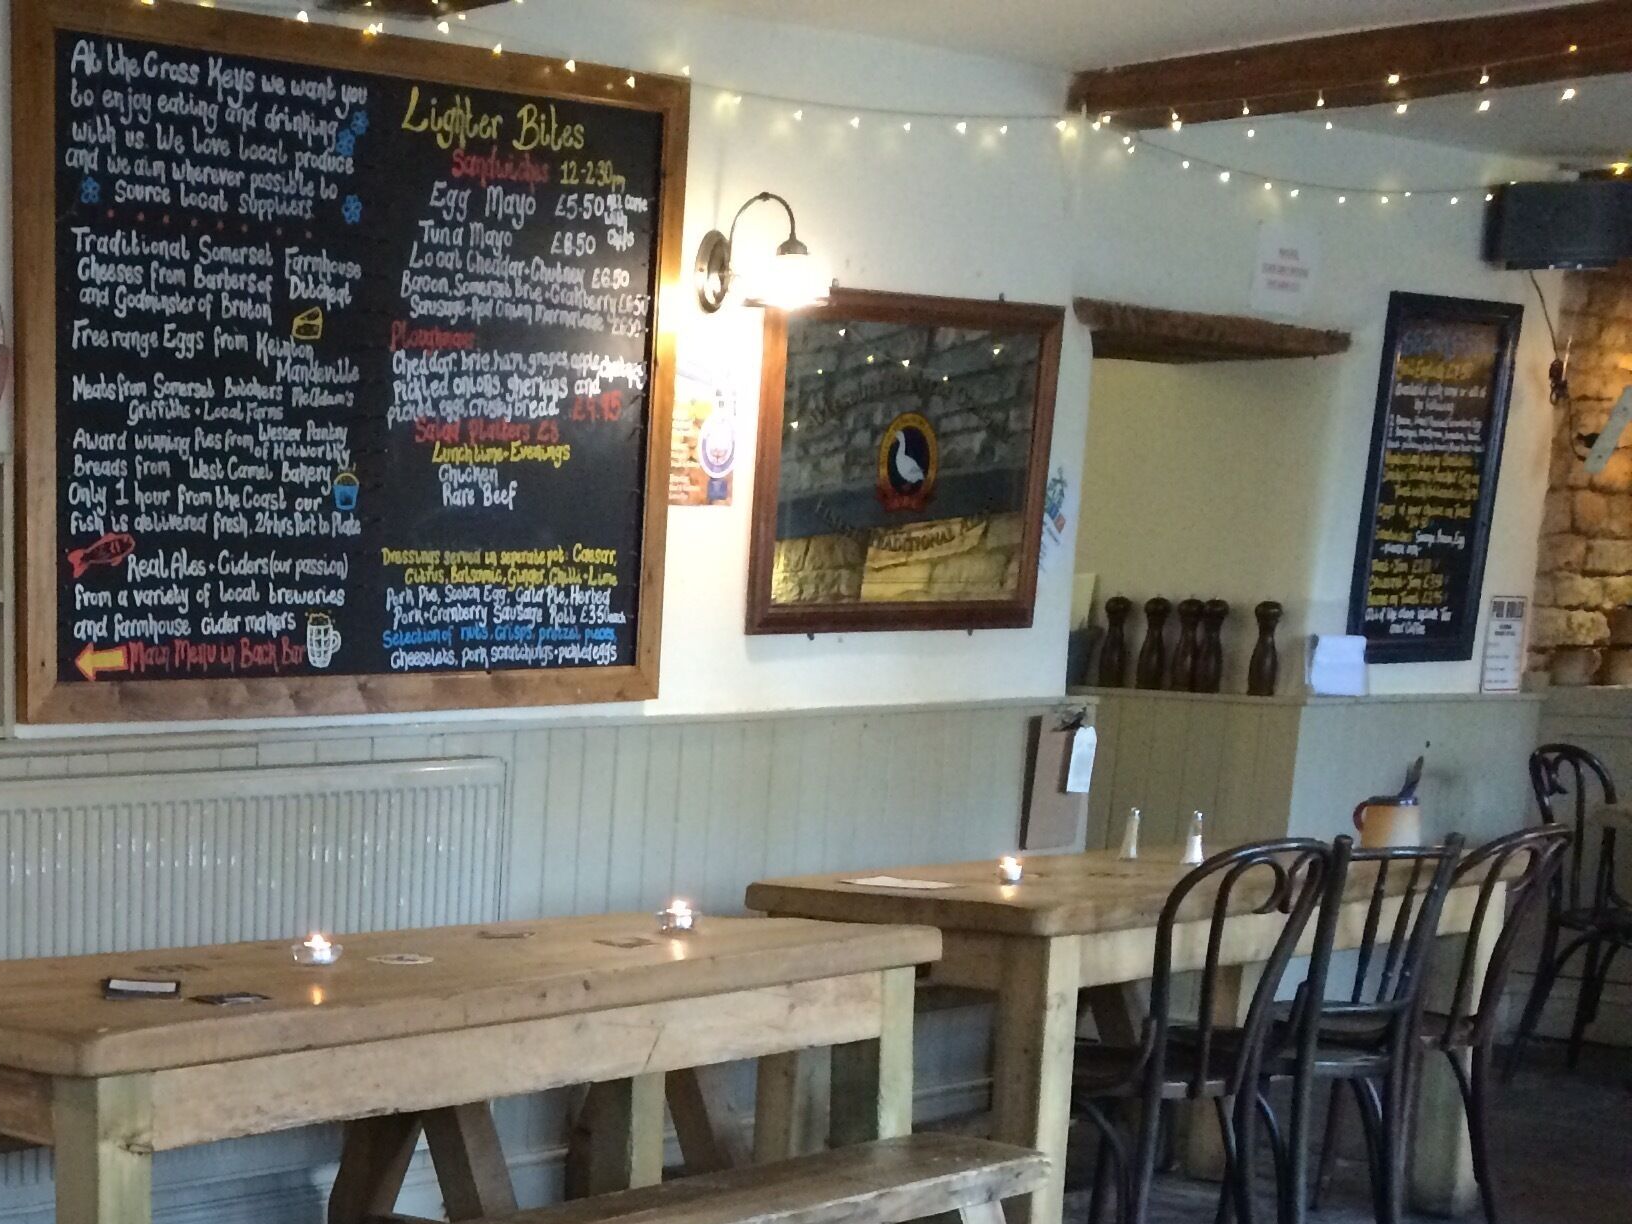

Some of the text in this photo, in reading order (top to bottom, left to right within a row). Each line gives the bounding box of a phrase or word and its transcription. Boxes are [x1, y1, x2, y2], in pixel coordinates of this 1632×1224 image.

[71, 39, 368, 120] At the Cross Keys we want you
[70, 77, 339, 153] to enjoy eating and drinking
[401, 86, 586, 151] Lighter Bites
[71, 114, 117, 155] with
[155, 122, 185, 154] We
[294, 151, 355, 181] produce
[65, 147, 339, 200] and we aim wherever possible to
[429, 180, 472, 222] Egg
[484, 184, 537, 230] Mayo
[554, 193, 605, 220] £5.50
[70, 226, 363, 284] Traditional Somerset Farmhouse
[409, 240, 463, 271] Local
[418, 219, 513, 257] Tuna Mayo
[77, 253, 144, 286] Cheeses
[150, 260, 187, 293] from
[194, 263, 257, 294] Barbers
[257, 274, 273, 303] of
[79, 285, 110, 309] and
[197, 292, 214, 321] of
[221, 291, 273, 326] Bruton
[71, 318, 110, 350] Free
[111, 329, 159, 358] range
[162, 322, 205, 359] Eggs
[213, 325, 249, 358] from
[72, 371, 284, 403] Meats from Somerset Butchers
[275, 356, 361, 387] Mandeville
[203, 399, 245, 422] Local
[246, 401, 285, 425] Farms
[72, 427, 128, 452] Award
[134, 428, 191, 461] winning
[194, 425, 223, 453] Pies
[224, 428, 255, 454] from
[254, 441, 270, 461] of
[73, 453, 332, 497] Breads from West Camel Bakery
[438, 463, 499, 489] Chicken
[68, 477, 323, 517] Only 1 hour from the Coast our
[442, 480, 518, 511] Rare Beef
[70, 510, 105, 537] Fish
[110, 510, 129, 533] is
[133, 510, 209, 535] delivered
[318, 513, 330, 536] to
[331, 511, 362, 539] Plate
[127, 548, 169, 583] Real
[170, 547, 207, 580] Ales
[217, 548, 269, 576] Ciders
[294, 552, 349, 582] passion)
[74, 583, 112, 611] from
[117, 589, 129, 608] a
[132, 583, 190, 614] variety
[195, 582, 212, 609] of
[268, 581, 346, 607] breweries
[444, 584, 481, 603] Scotch
[73, 610, 297, 644] and farmhouse cider makers
[393, 605, 425, 631] Pork
[429, 602, 488, 629] Cranberry
[492, 603, 543, 630] Sausage
[174, 639, 217, 672] Menu
[239, 636, 280, 673] Back
